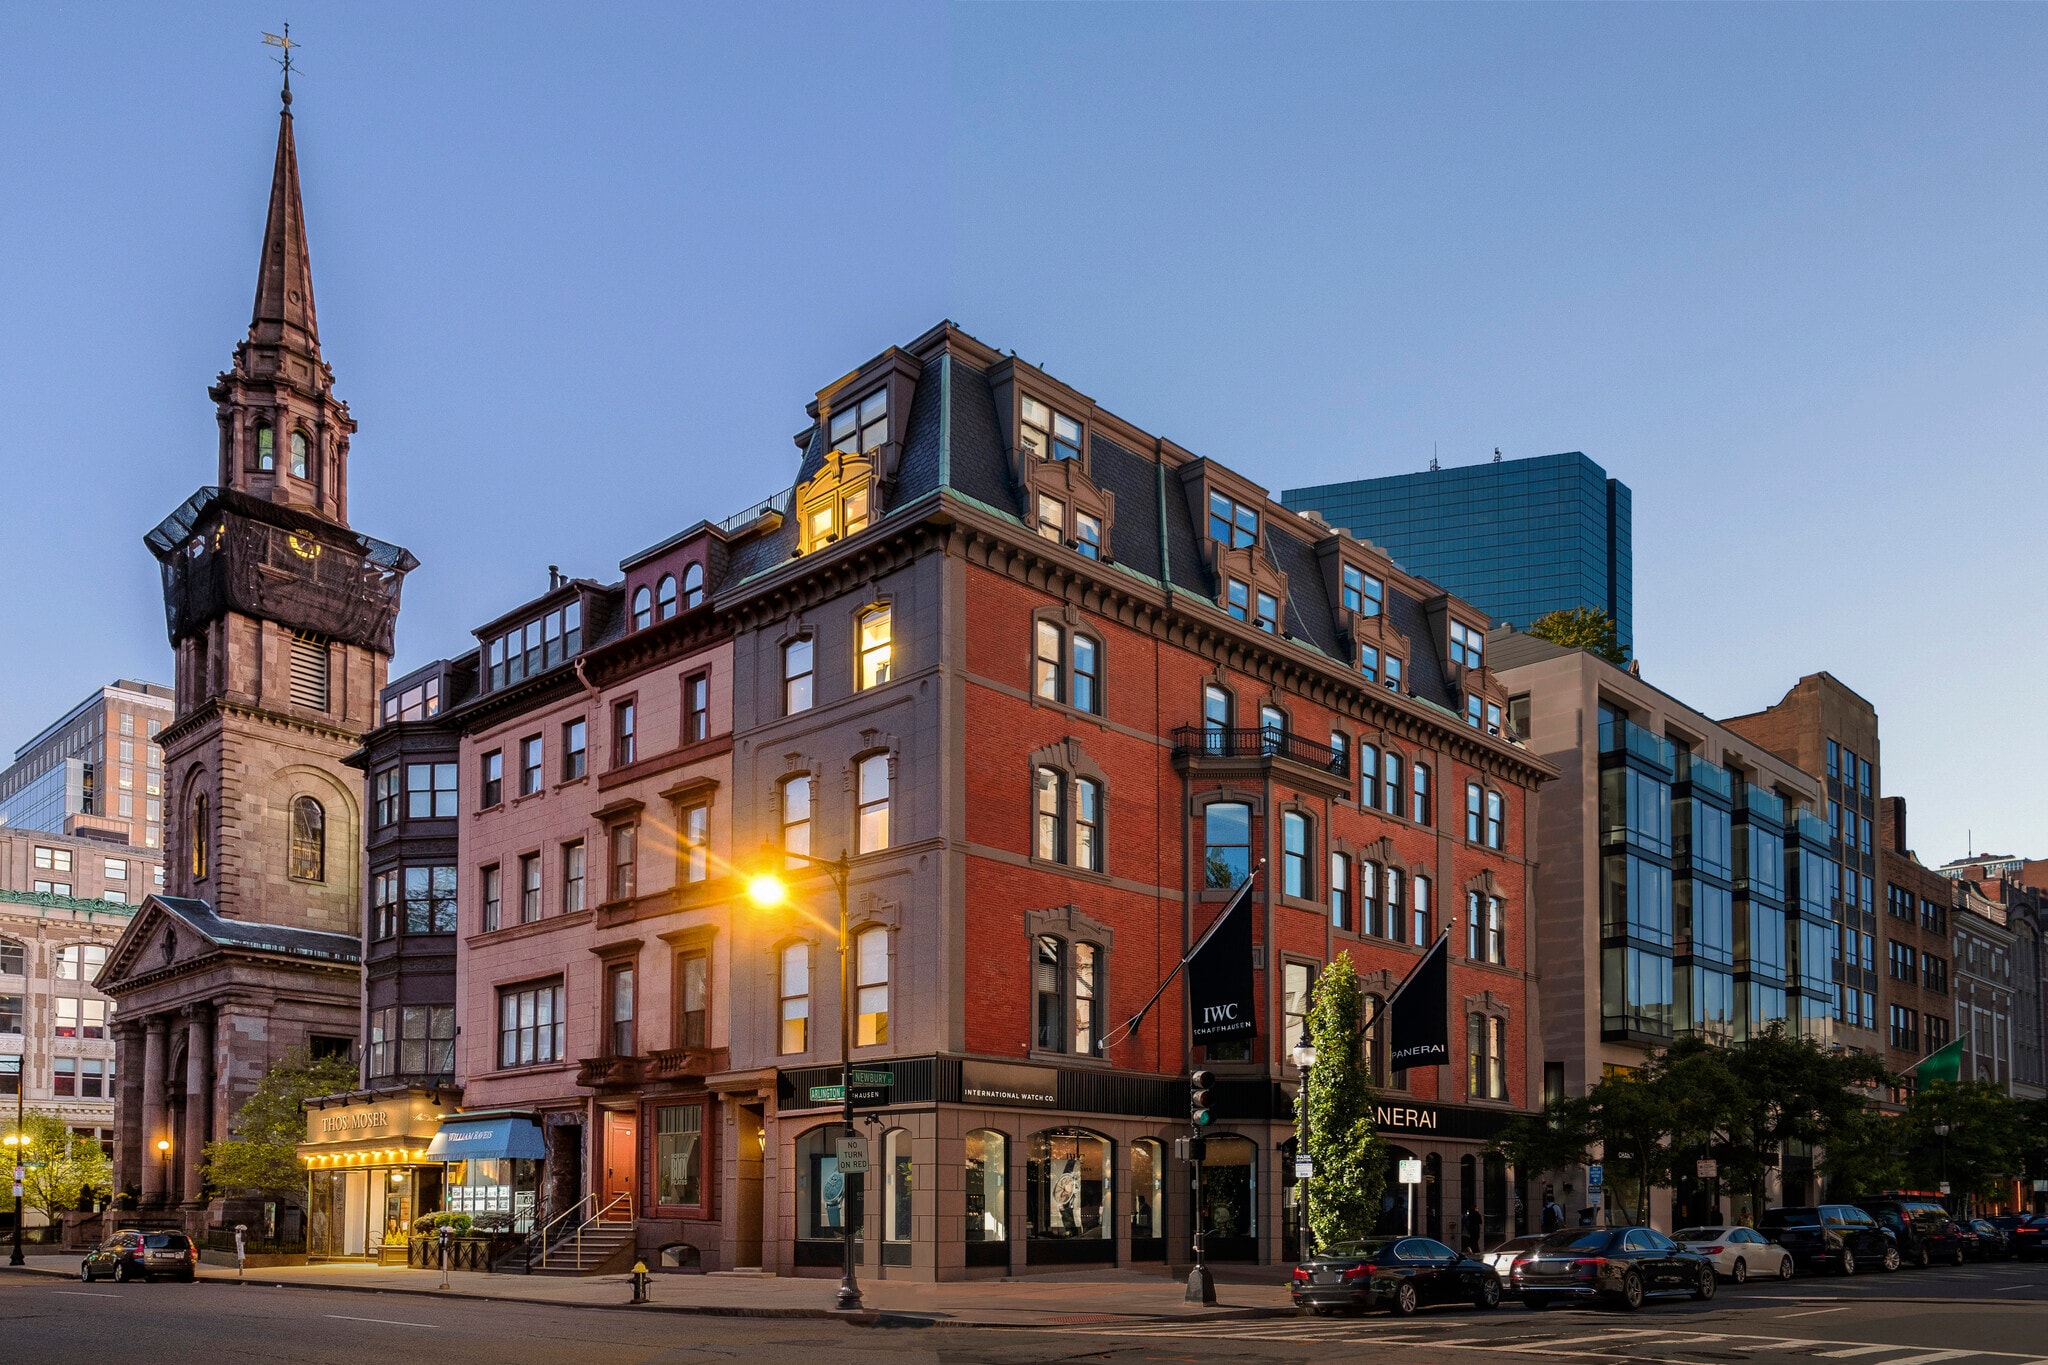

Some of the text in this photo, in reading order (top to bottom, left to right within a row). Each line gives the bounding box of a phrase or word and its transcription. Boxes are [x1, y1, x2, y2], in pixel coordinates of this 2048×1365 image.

[1203, 1003, 1238, 1023] IWC
[1193, 1021, 1251, 1035] SCHAFFHAUSEN
[1391, 1044, 1444, 1059] PANERAI
[855, 1073, 887, 1083] NEWBURY
[811, 1088, 841, 1099] ARLINGTON
[964, 1089, 1020, 1099] INTERNATIONAL
[1021, 1093, 1044, 1101] WATCH
[322, 1111, 388, 1133] THOS. MOSER
[448, 1131, 474, 1142] WILLIAM
[847, 1141, 858, 1149] NO
[844, 1151, 863, 1159] TURN
[671, 1158, 688, 1180] BODY
[840, 1160, 867, 1169] ON RED
